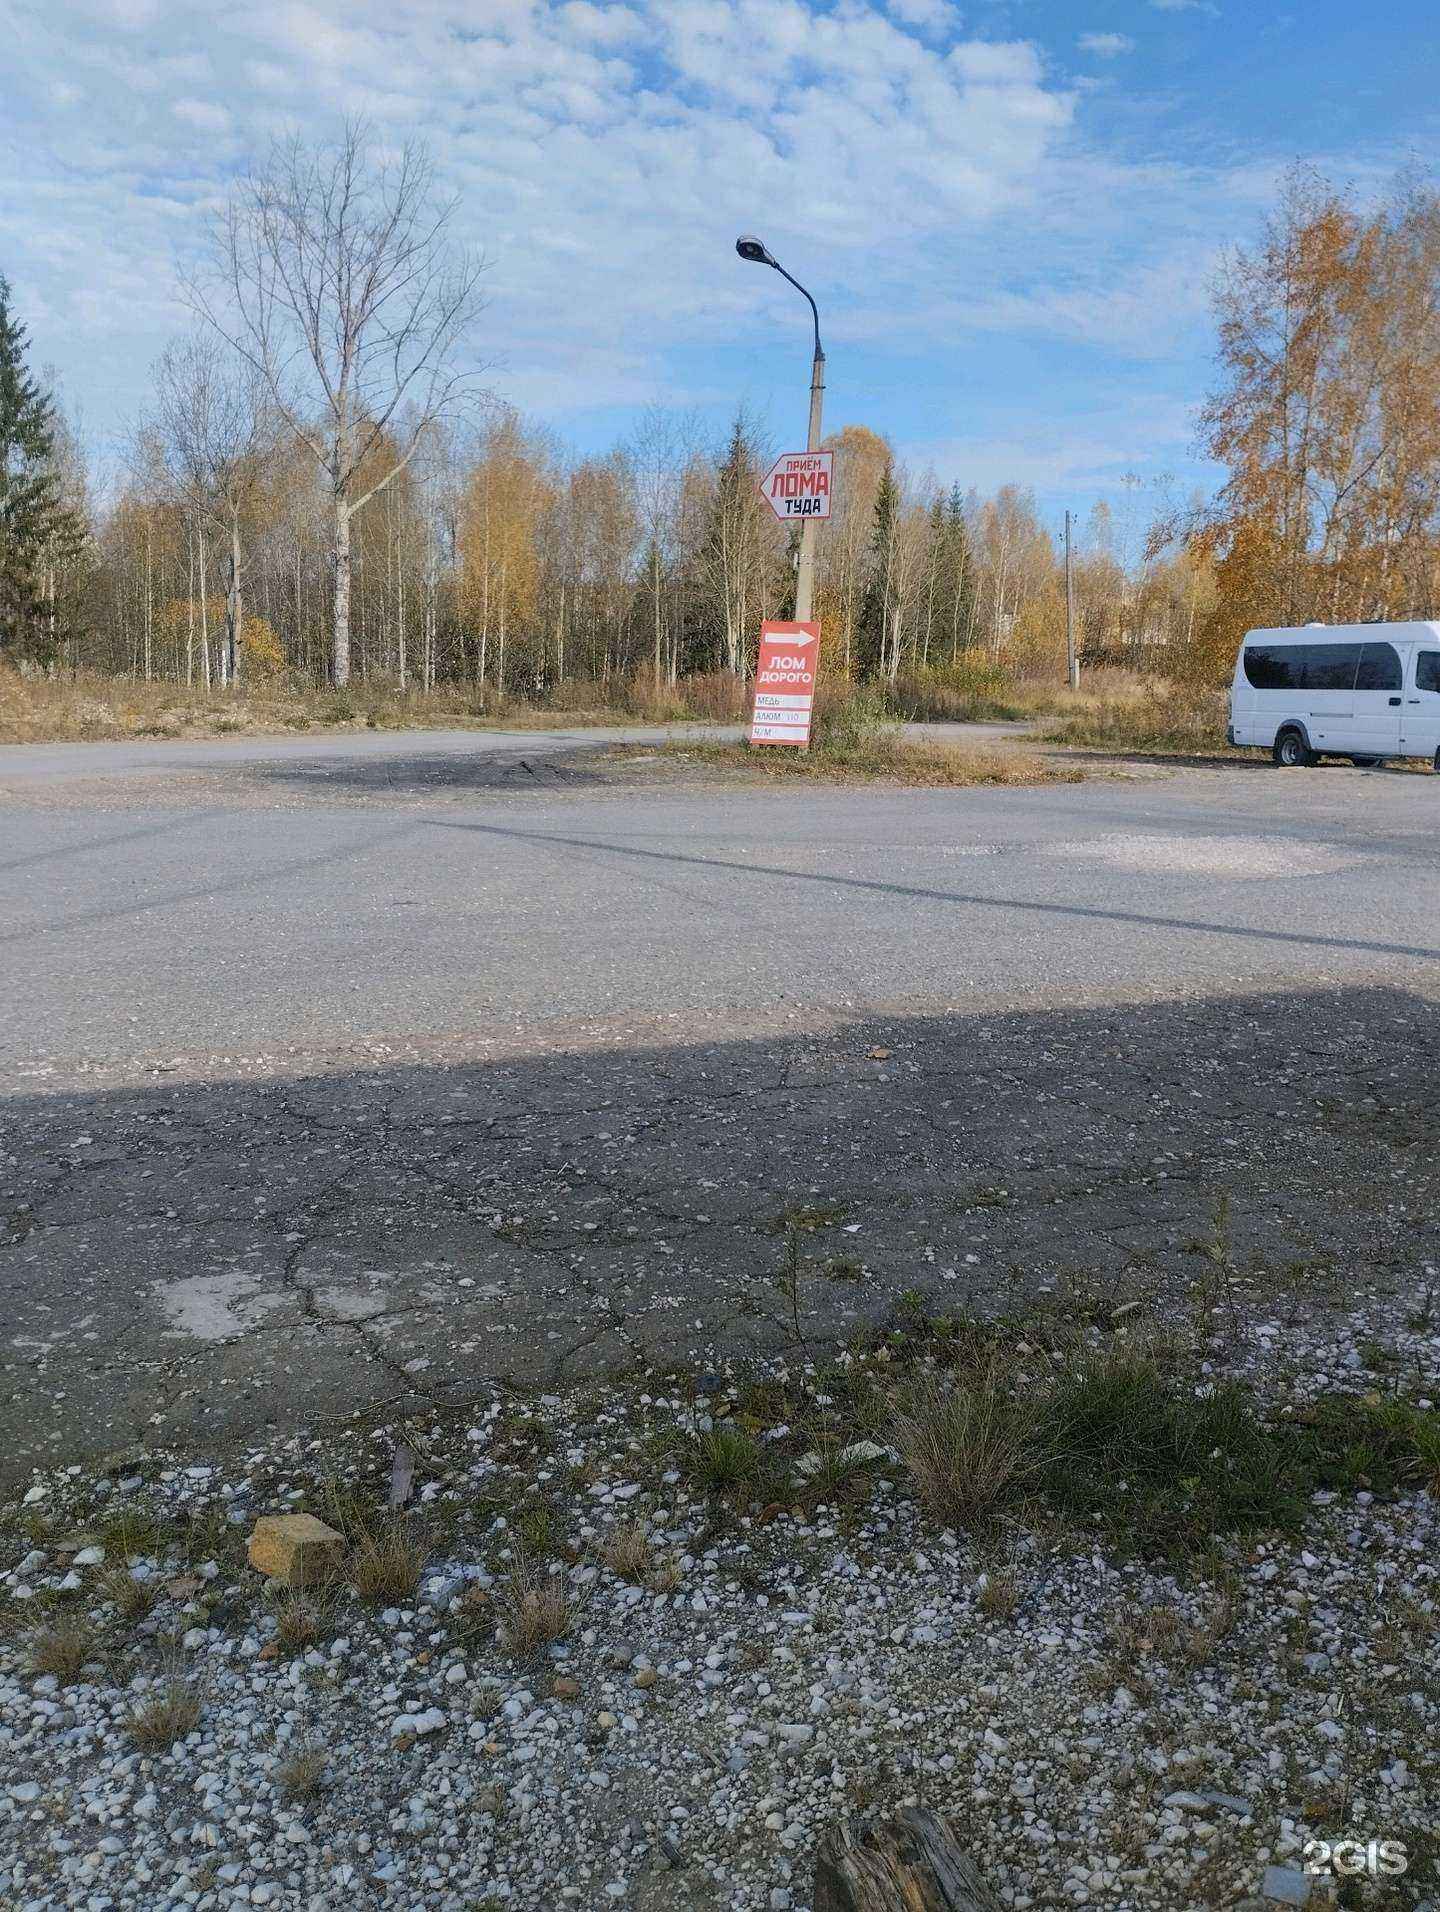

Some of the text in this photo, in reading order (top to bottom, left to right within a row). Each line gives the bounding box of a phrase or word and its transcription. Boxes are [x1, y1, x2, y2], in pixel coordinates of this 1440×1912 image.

[787, 456, 821, 471] ПРИЁМ
[771, 472, 829, 497] ЛОМА
[785, 498, 821, 515] ТУДА
[769, 656, 806, 670] ЛОМ
[760, 671, 812, 683] ДОРОГО
[758, 696, 780, 705] МЕДЬ
